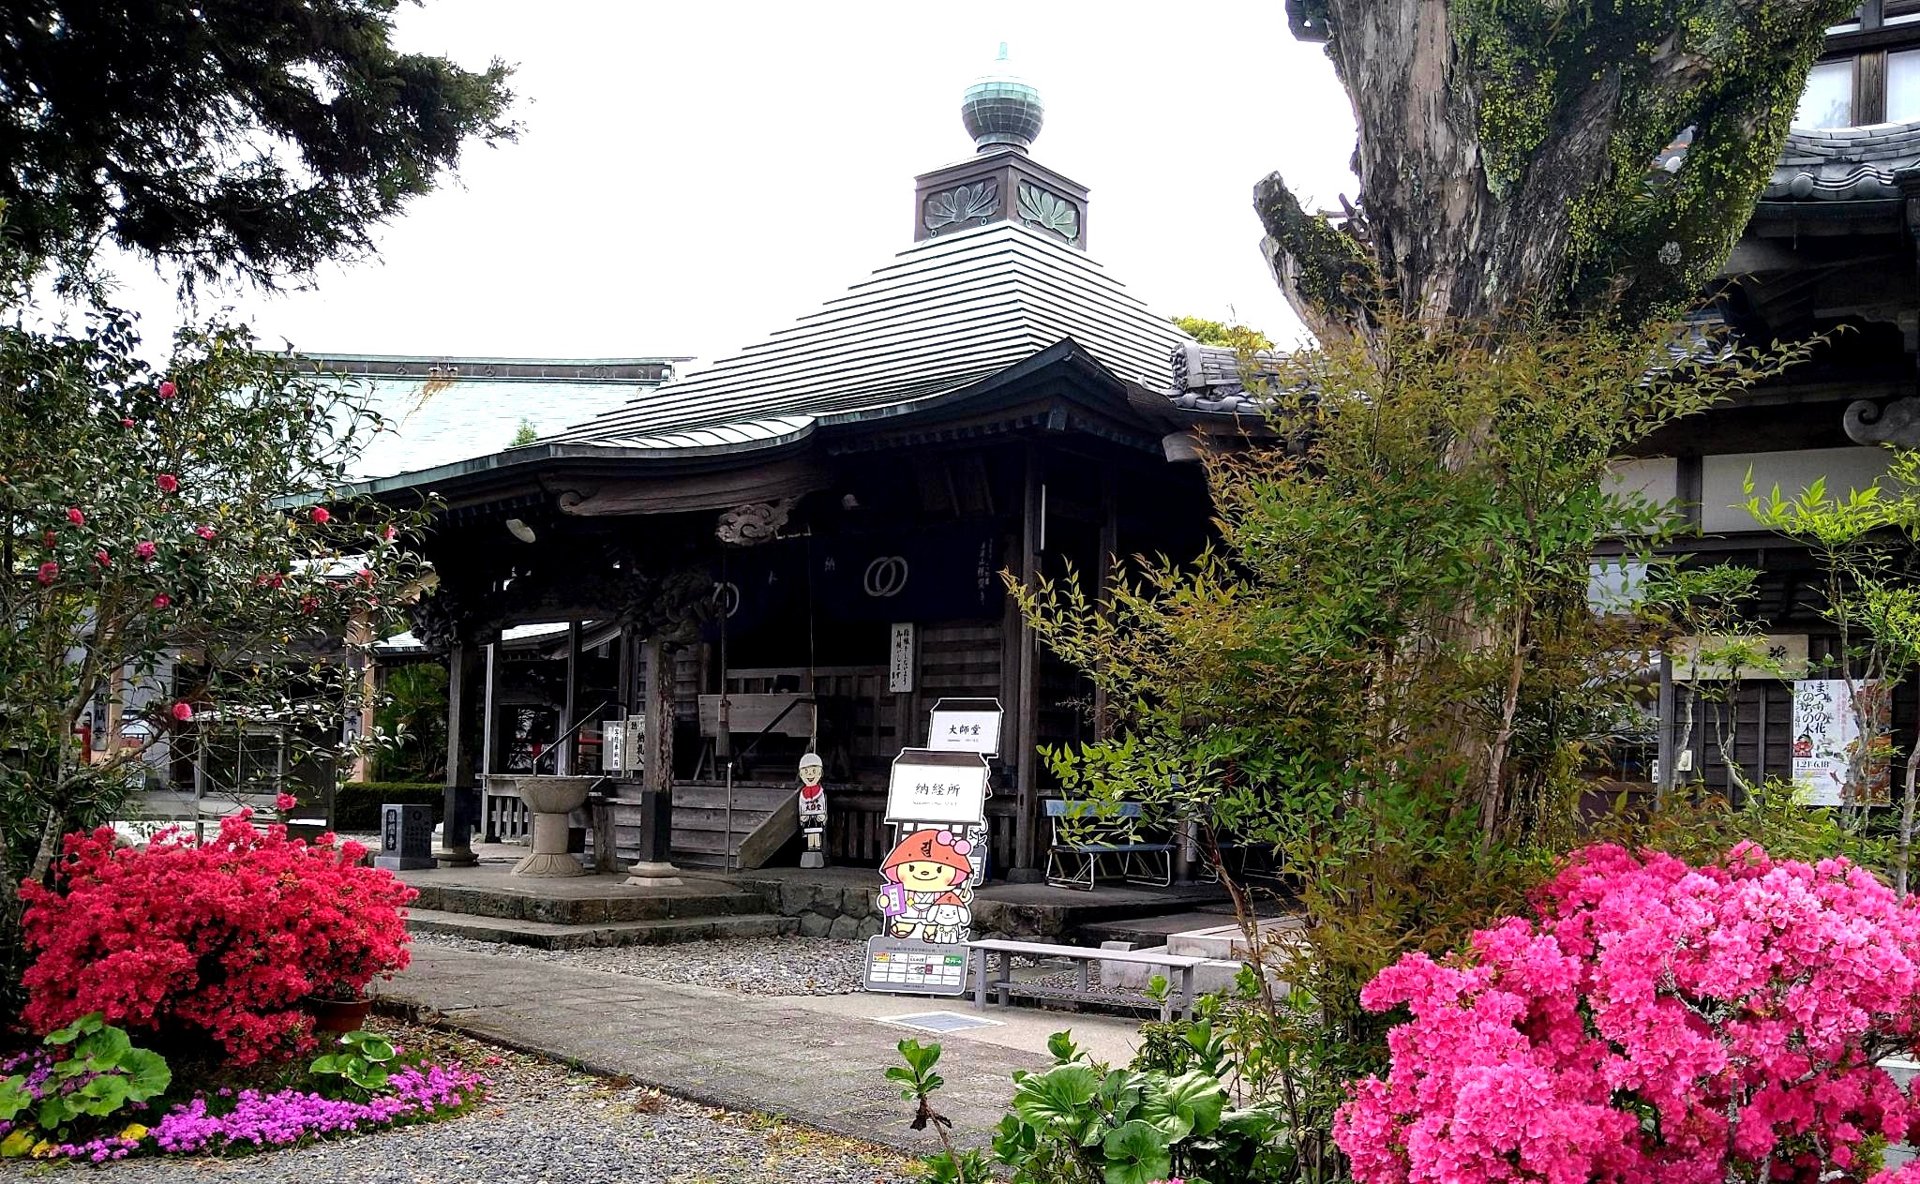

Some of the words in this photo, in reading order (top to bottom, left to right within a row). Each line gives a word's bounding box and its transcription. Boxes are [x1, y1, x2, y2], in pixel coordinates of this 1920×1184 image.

[948, 724, 981, 735] 大師堂
[915, 782, 961, 797] 納経所
